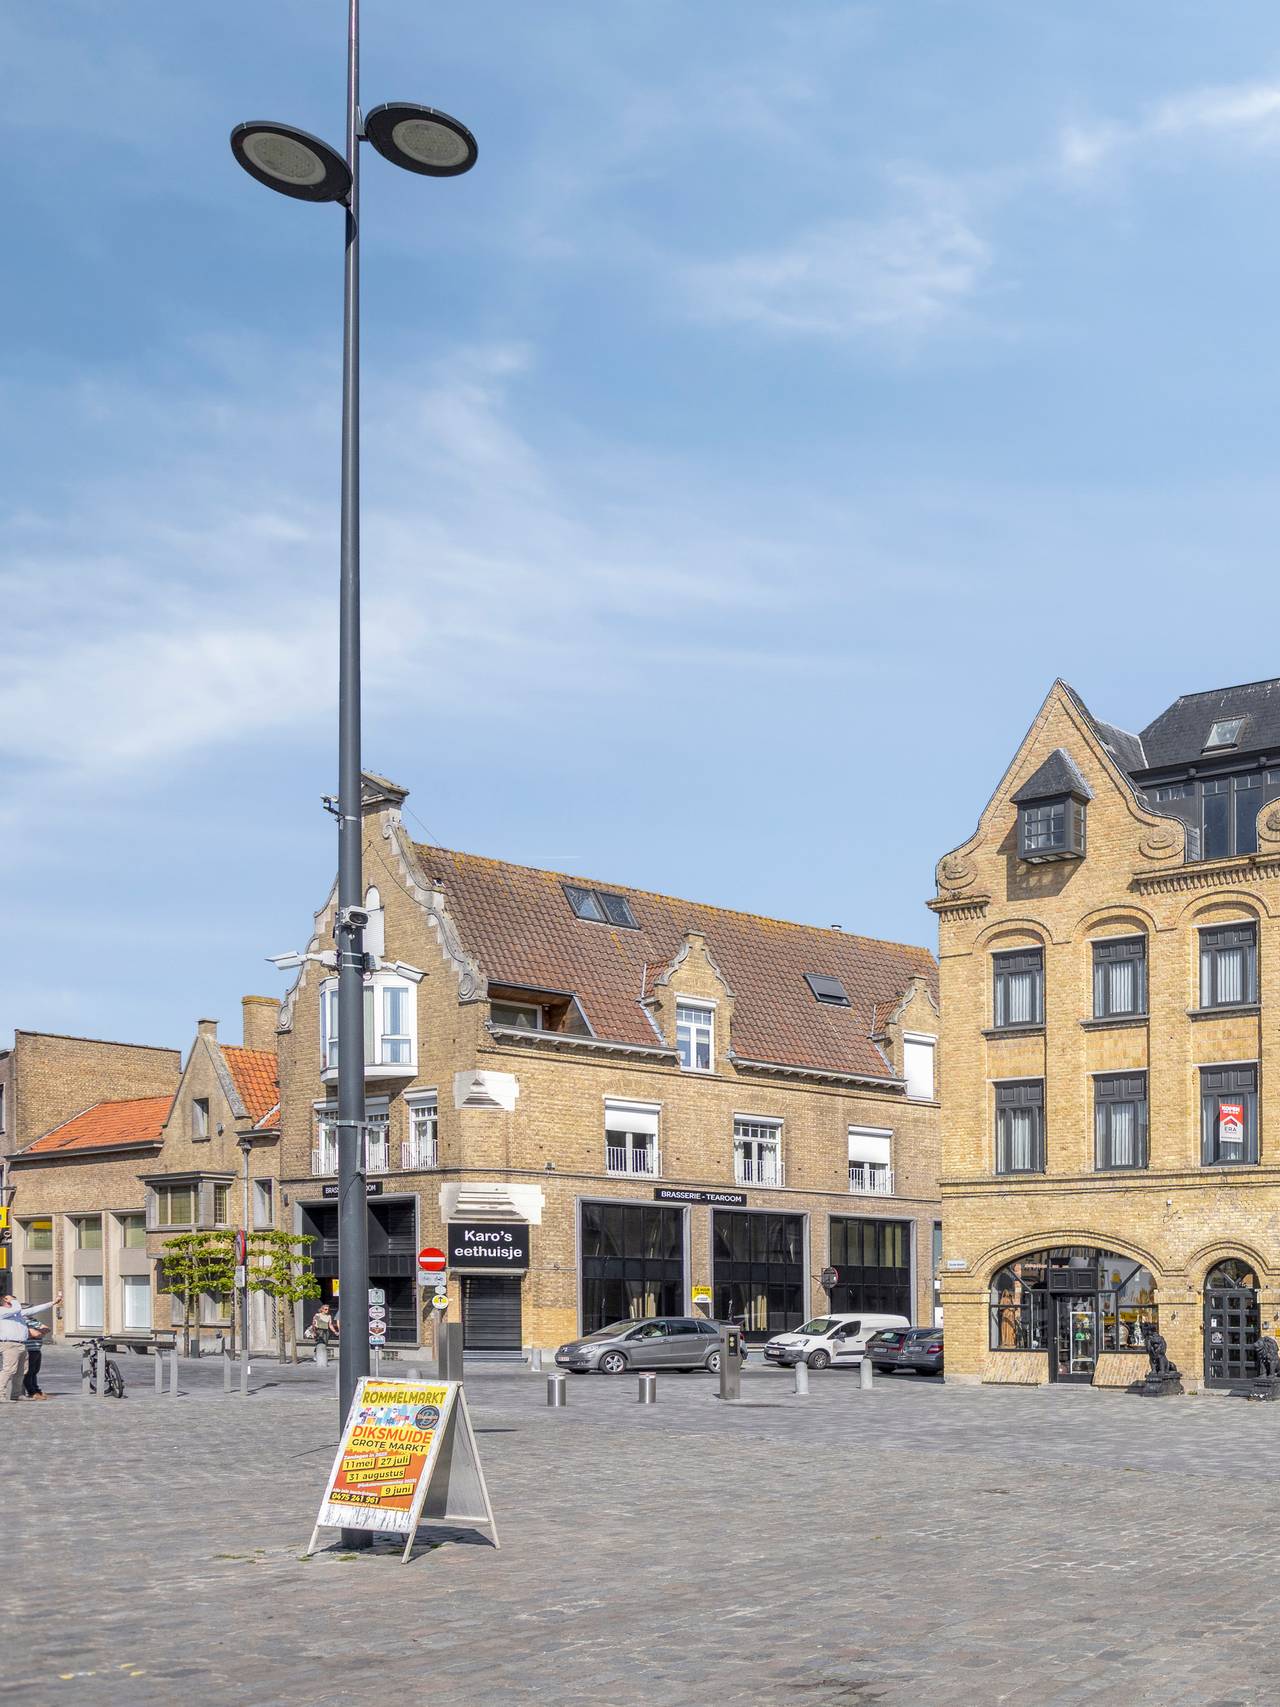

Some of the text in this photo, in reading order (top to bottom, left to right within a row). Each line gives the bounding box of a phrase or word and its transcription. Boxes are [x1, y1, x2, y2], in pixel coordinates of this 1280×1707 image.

[661, 1191, 701, 1200] BRASSERIE
[706, 1194, 742, 1202] TEAROOM
[464, 1230, 513, 1242] Karo’s
[454, 1245, 523, 1260] eethuisje
[362, 1391, 447, 1404] ROMMELMARKT
[352, 1425, 433, 1444] DIKSMUIDE
[352, 1438, 426, 1453] GROTE MARKT
[380, 1457, 391, 1465] 27
[393, 1455, 409, 1466] juli
[349, 1470, 404, 1481] 31 augustus
[385, 1487, 391, 1495] 9
[393, 1485, 411, 1496] juni
[331, 1492, 350, 1501] 0475
[350, 1494, 364, 1502] 241
